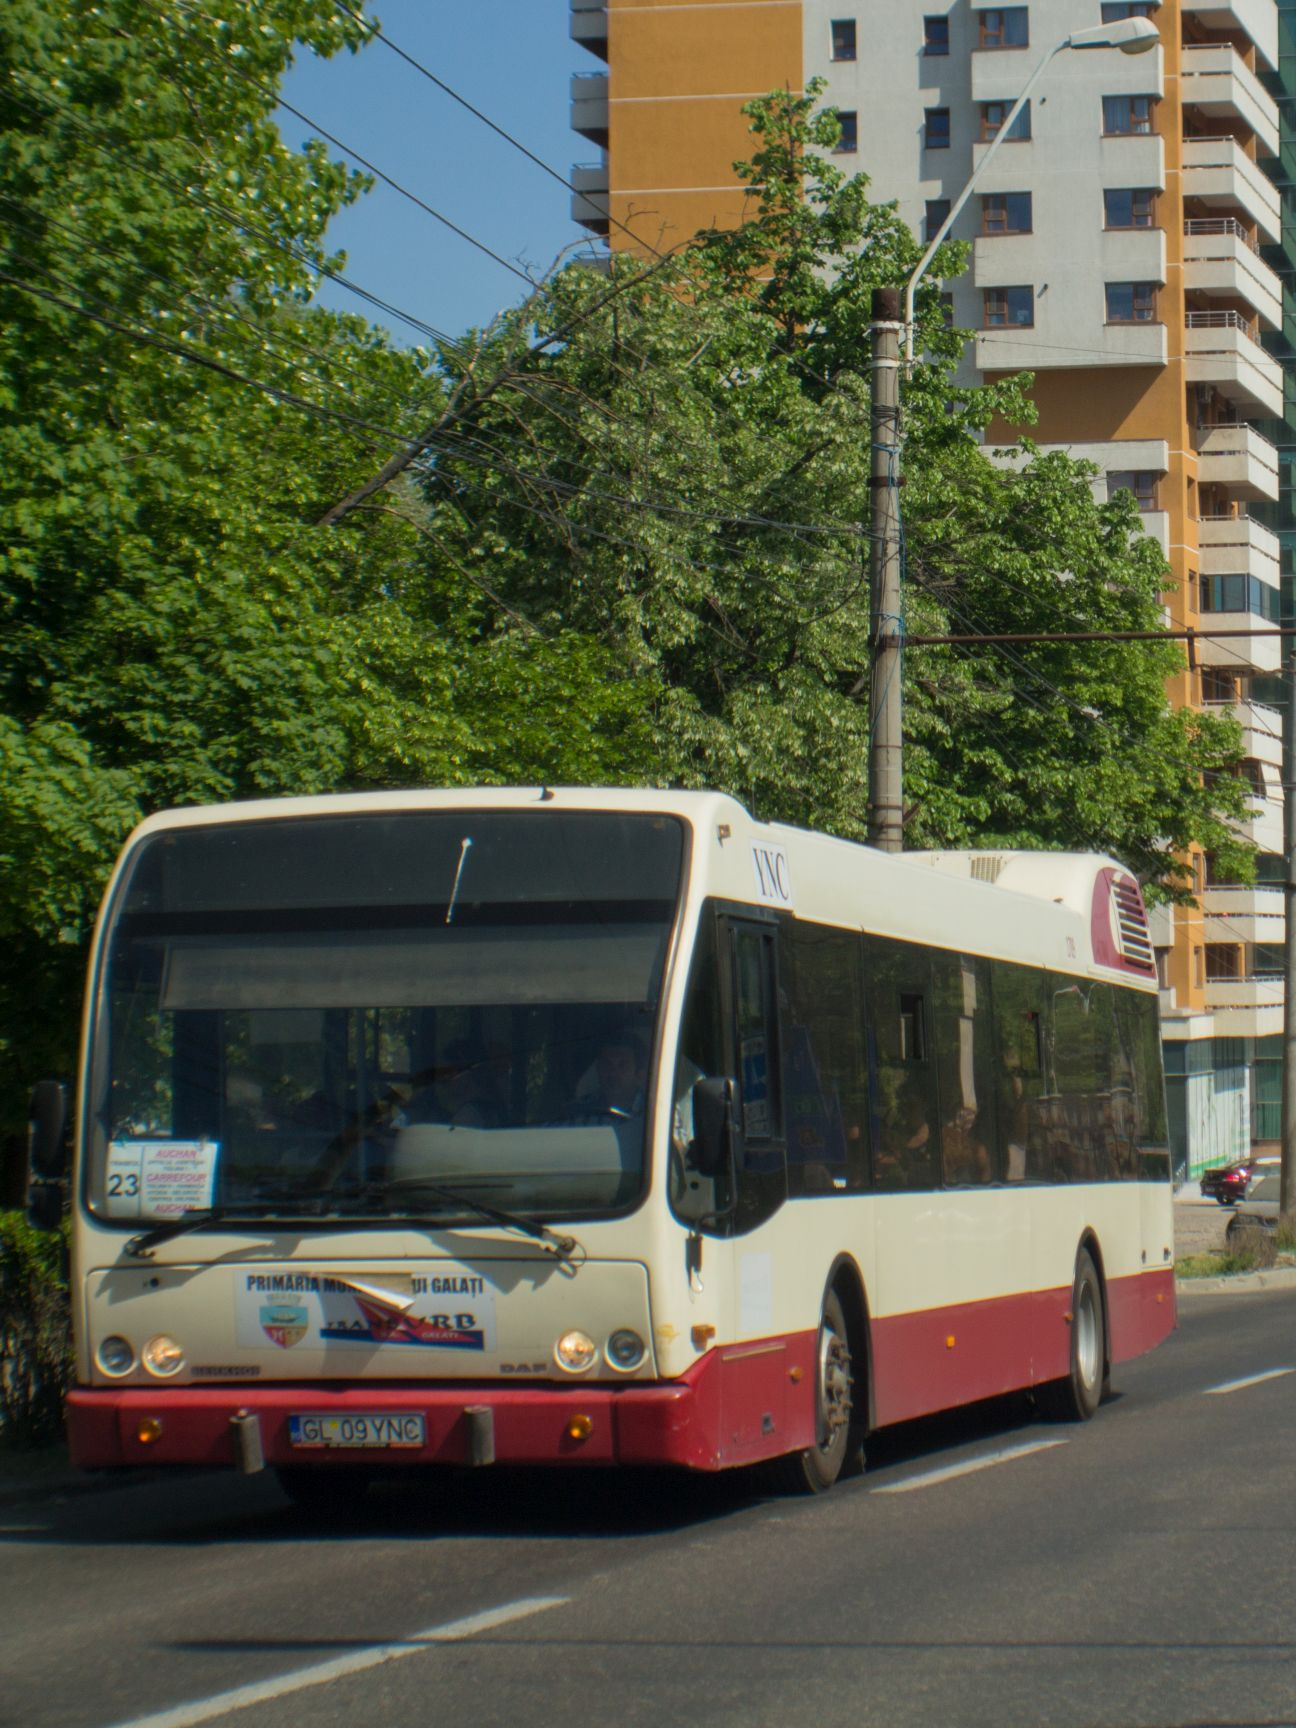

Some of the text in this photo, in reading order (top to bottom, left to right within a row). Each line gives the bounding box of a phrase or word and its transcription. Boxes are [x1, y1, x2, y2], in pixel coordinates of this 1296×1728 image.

[752, 847, 789, 901] YNC
[155, 1149, 198, 1159] AUCHAN
[108, 1173, 139, 1197] 23
[146, 1173, 206, 1183] CARREFOUR
[500, 1363, 546, 1373] DAF
[303, 1419, 332, 1441] GL
